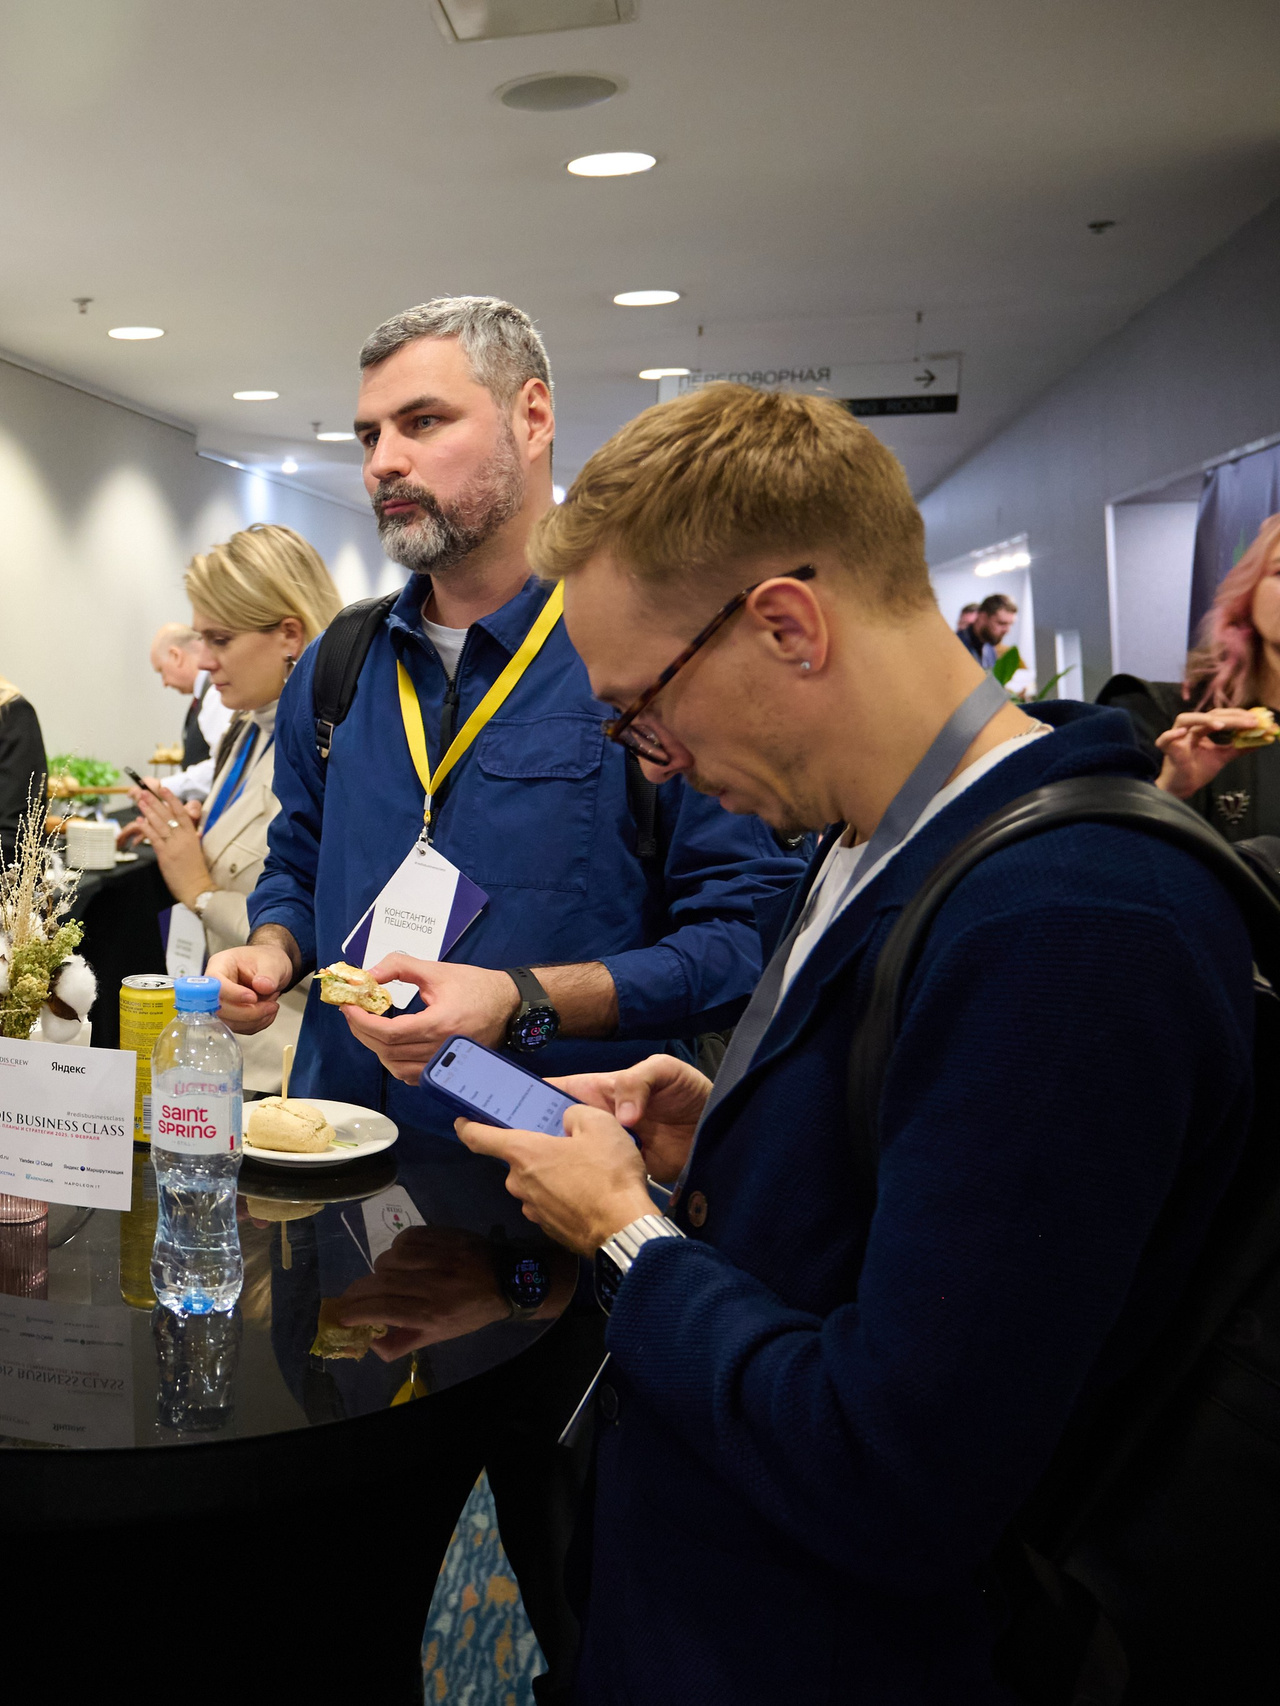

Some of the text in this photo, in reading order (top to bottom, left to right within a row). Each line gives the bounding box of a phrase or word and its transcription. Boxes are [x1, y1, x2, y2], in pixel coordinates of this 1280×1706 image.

[384, 907, 436, 926] КОНСТАНТИН
[384, 917, 433, 935] ПЕШЕХОНОВ
[10, 1058, 29, 1066] CREW
[51, 1061, 86, 1074] Яндекс
[66, 1111, 125, 1122] #redisbusinessclass
[17, 1113, 79, 1132] BUSINESS
[82, 1122, 125, 1137] CLASS
